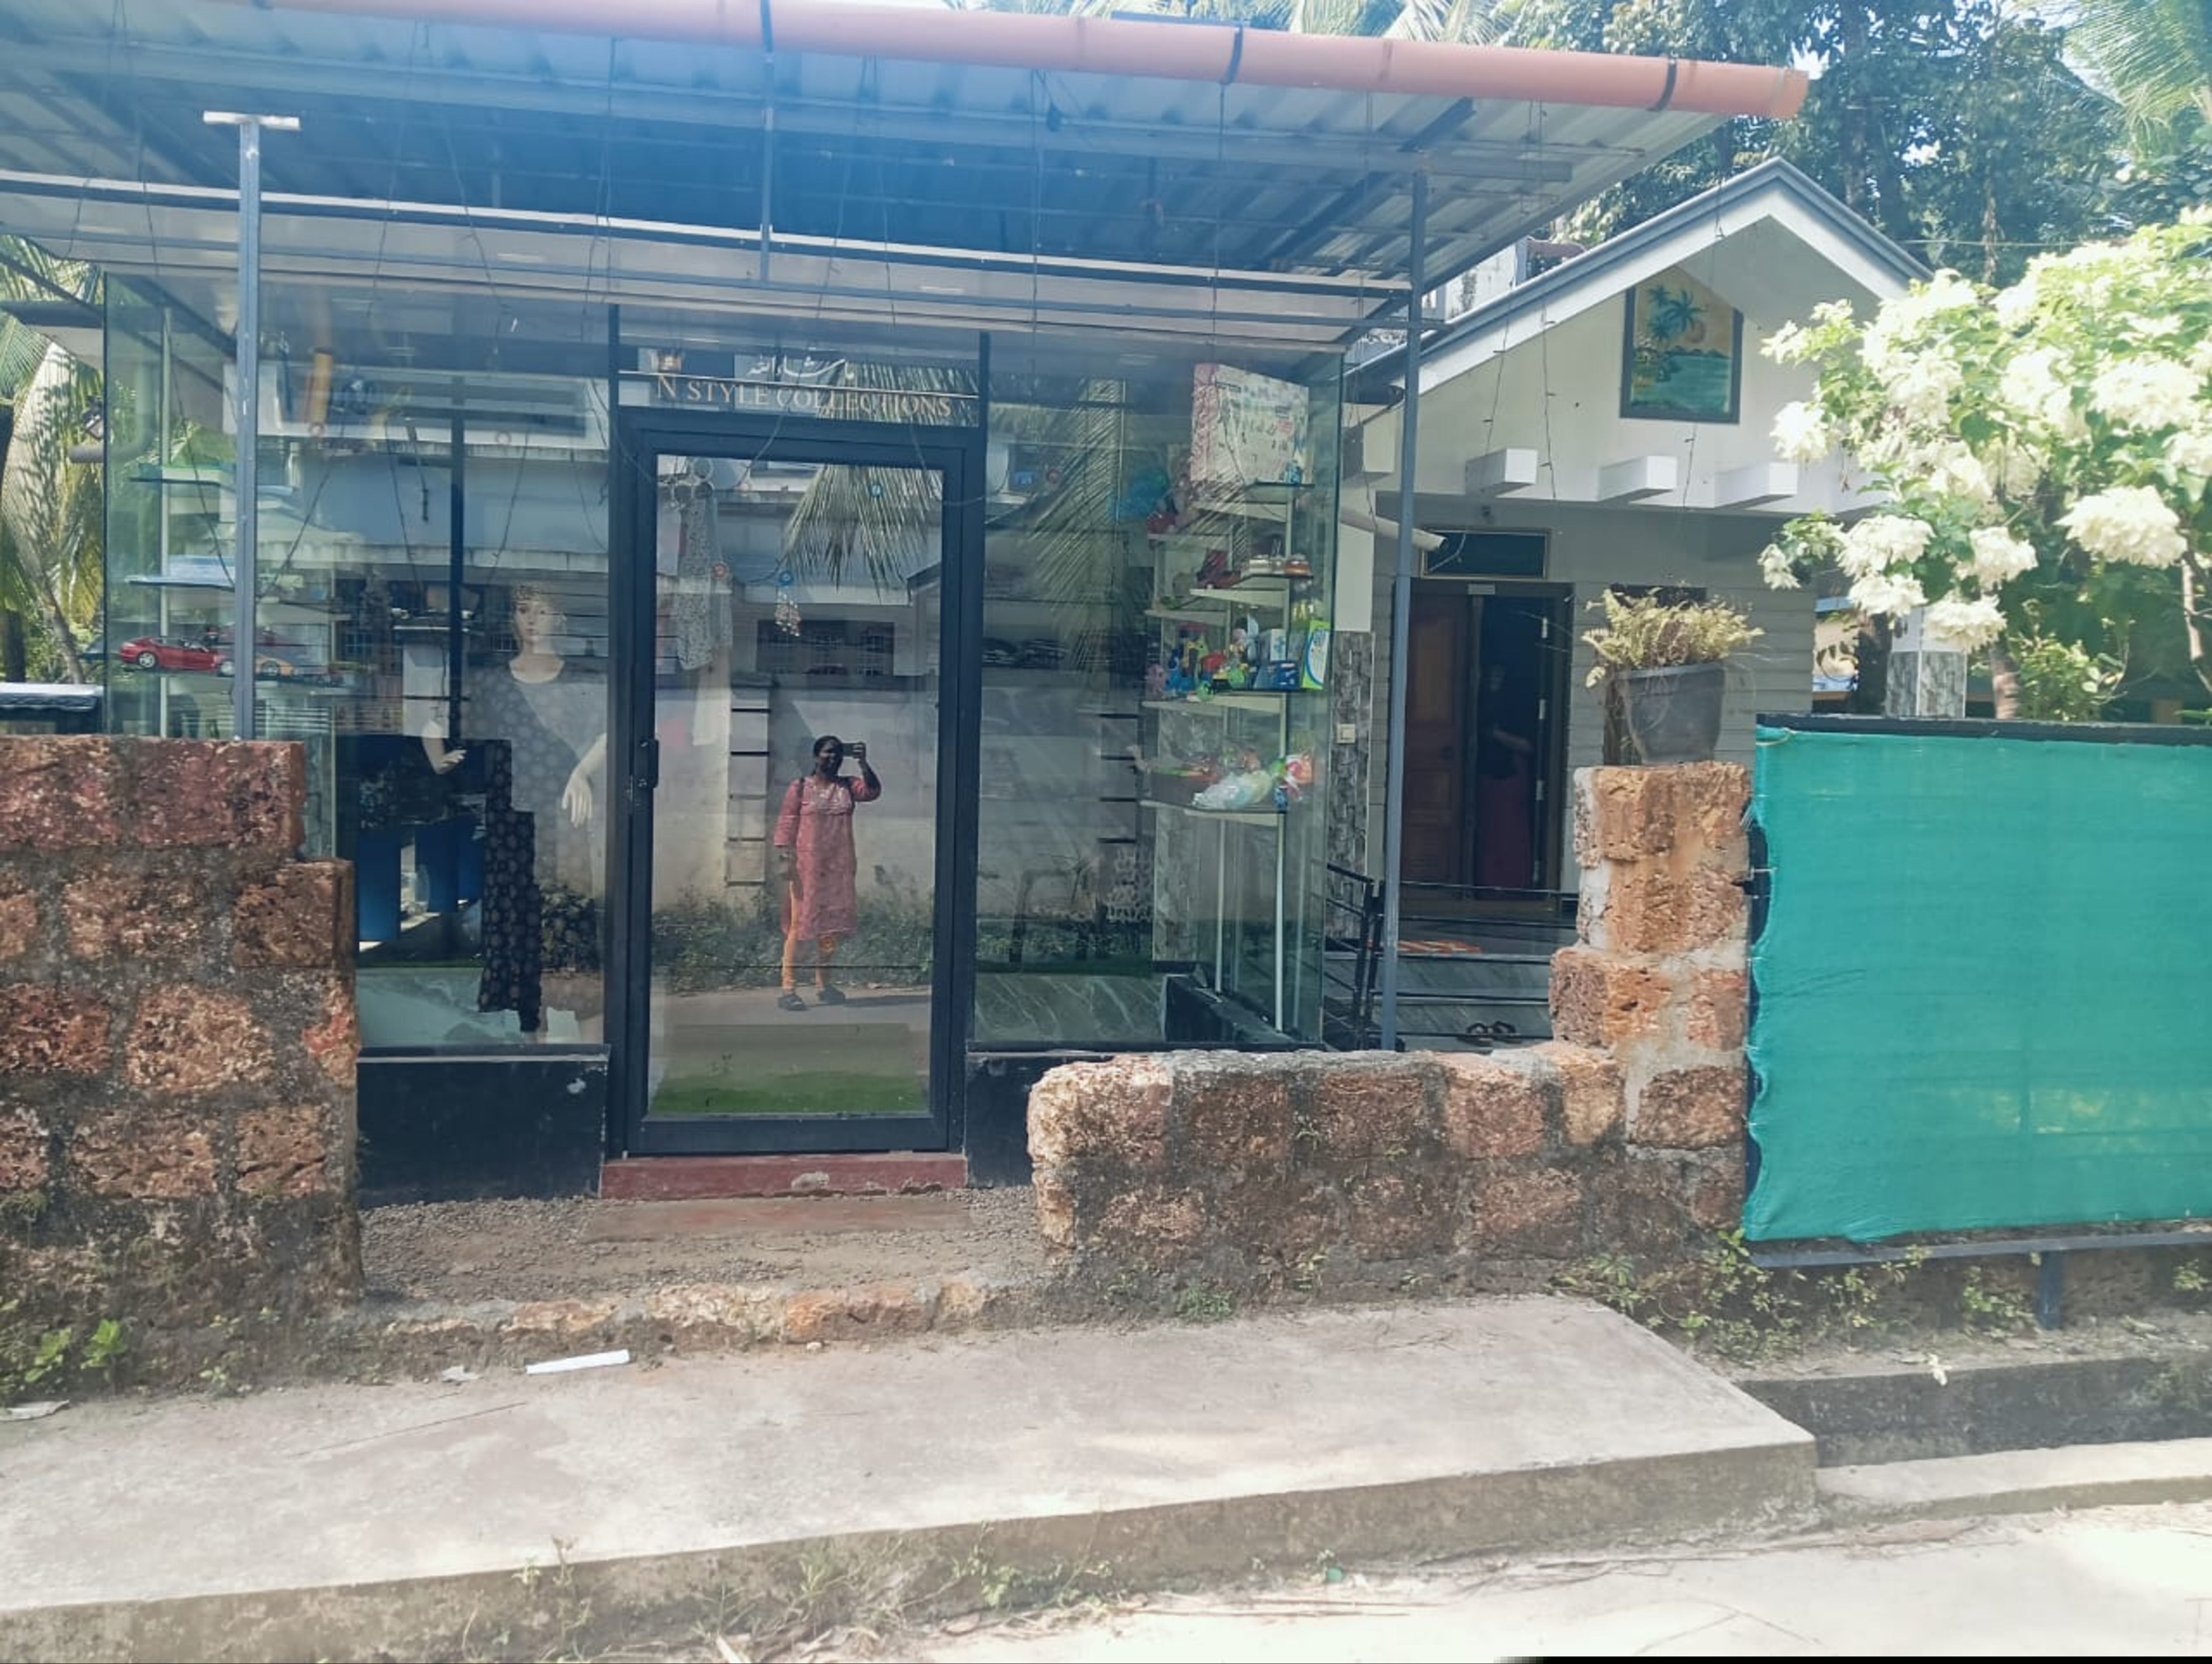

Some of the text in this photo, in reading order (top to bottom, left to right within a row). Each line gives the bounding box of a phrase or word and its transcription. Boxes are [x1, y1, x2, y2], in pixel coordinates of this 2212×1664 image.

[657, 376, 952, 417] N STYLE COLLECTIONS
